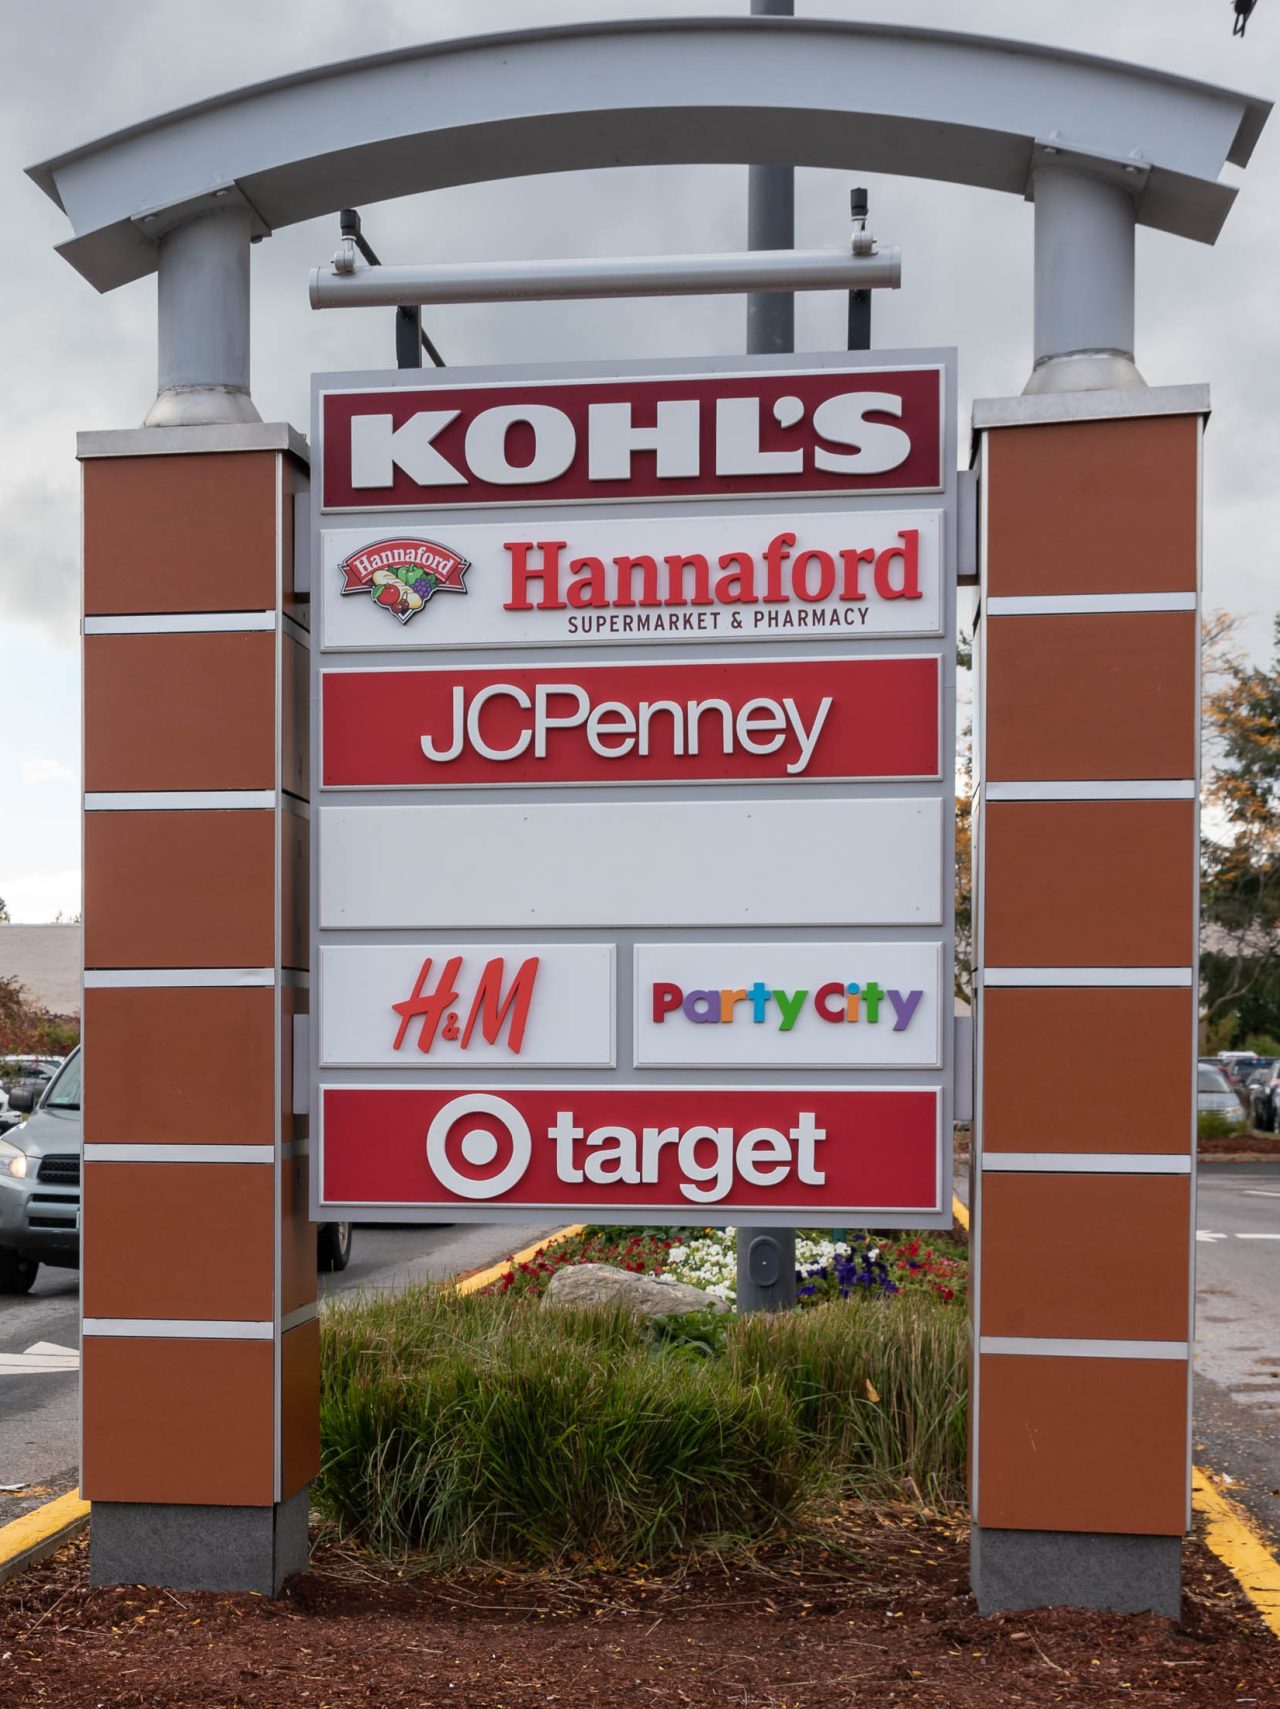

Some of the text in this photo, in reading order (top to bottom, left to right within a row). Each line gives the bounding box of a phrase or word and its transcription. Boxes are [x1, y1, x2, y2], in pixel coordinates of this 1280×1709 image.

[351, 391, 912, 489] KOHL'S
[353, 547, 455, 577] Hannaford
[503, 529, 923, 612] Hannaford
[568, 607, 870, 634] SUPERMARKET & PHARMACY
[420, 684, 833, 775] JCPenney
[392, 956, 540, 1055] H&M
[652, 981, 924, 1031] Party City
[548, 1111, 826, 1204] target
